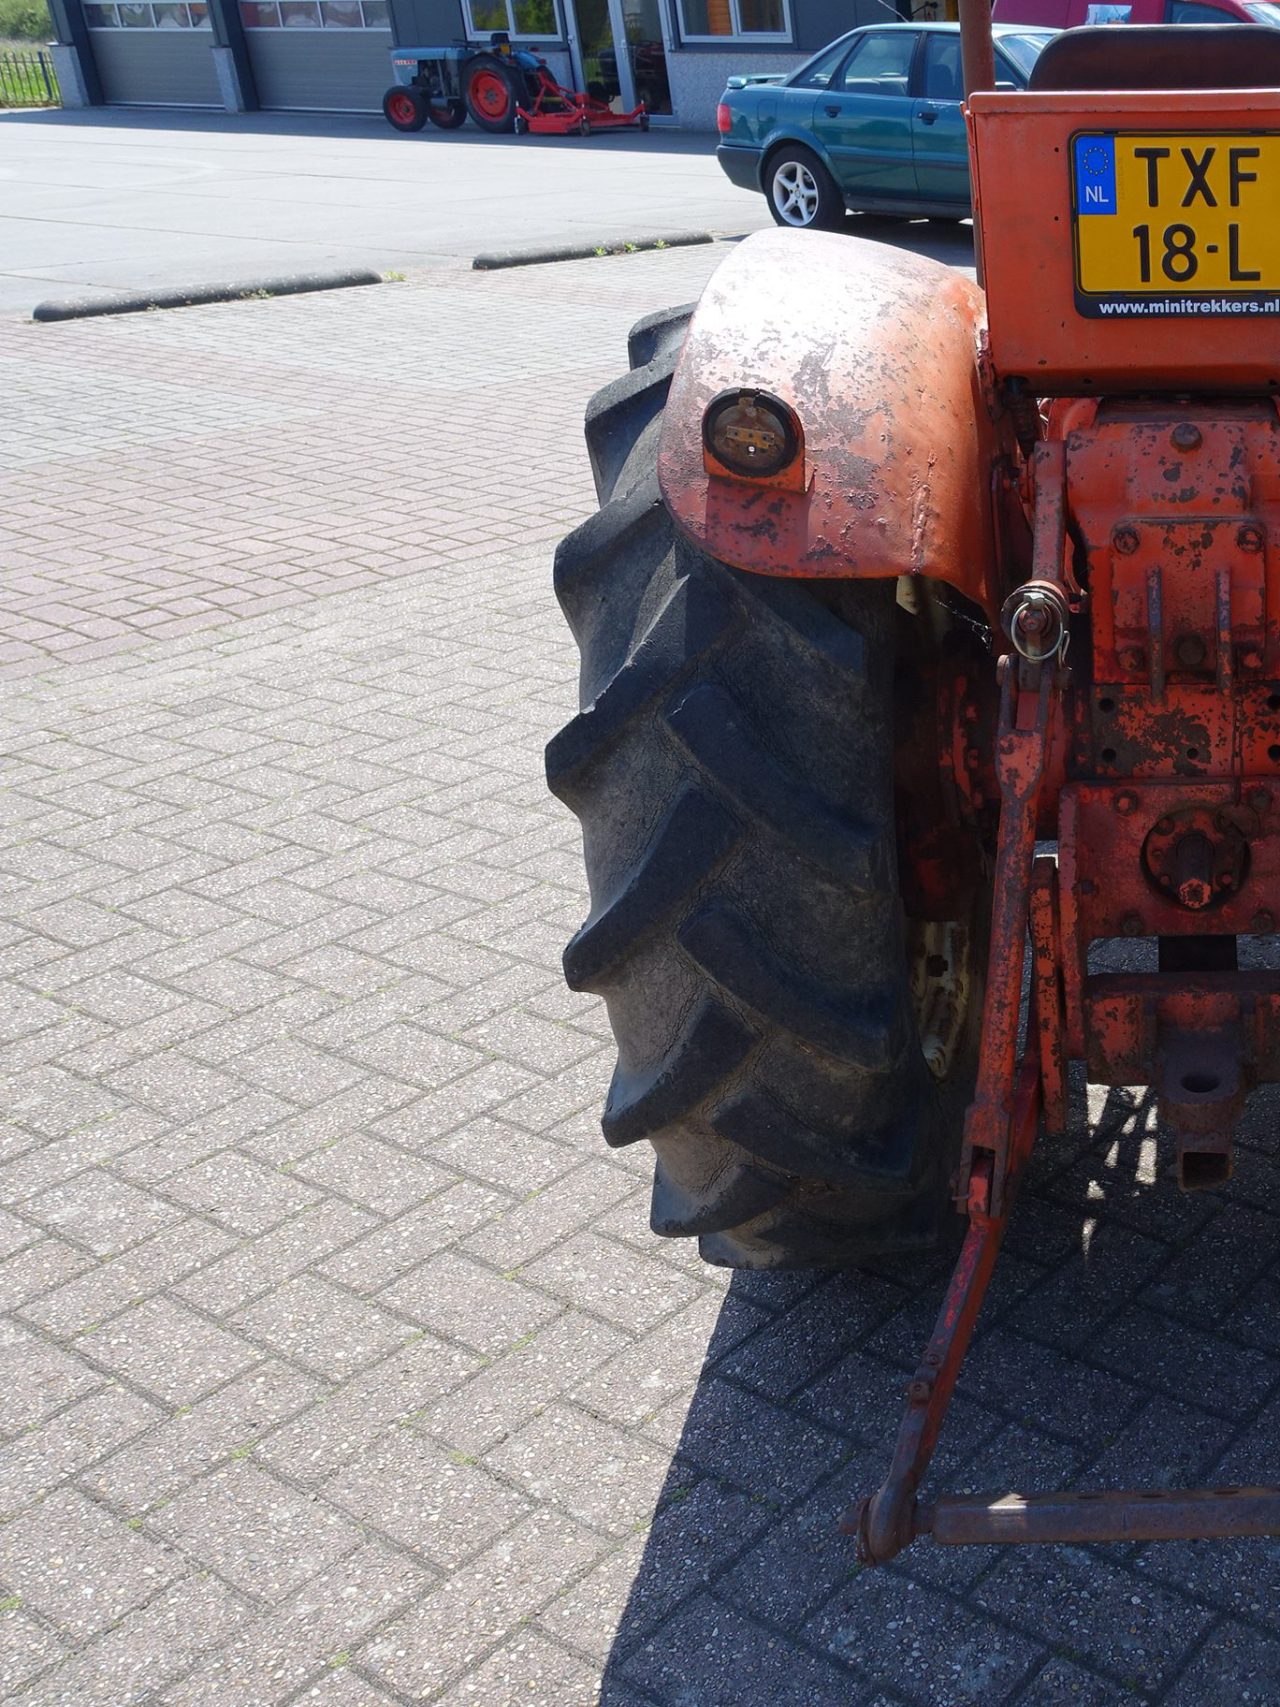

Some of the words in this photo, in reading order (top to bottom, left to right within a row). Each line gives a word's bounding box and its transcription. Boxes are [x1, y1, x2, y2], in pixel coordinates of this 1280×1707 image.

[1085, 185, 1109, 203] NL
[1134, 147, 1261, 208] TXF
[1132, 223, 1261, 283] 18-L
[1099, 299, 1280, 314] www.minitrekkers.nl
